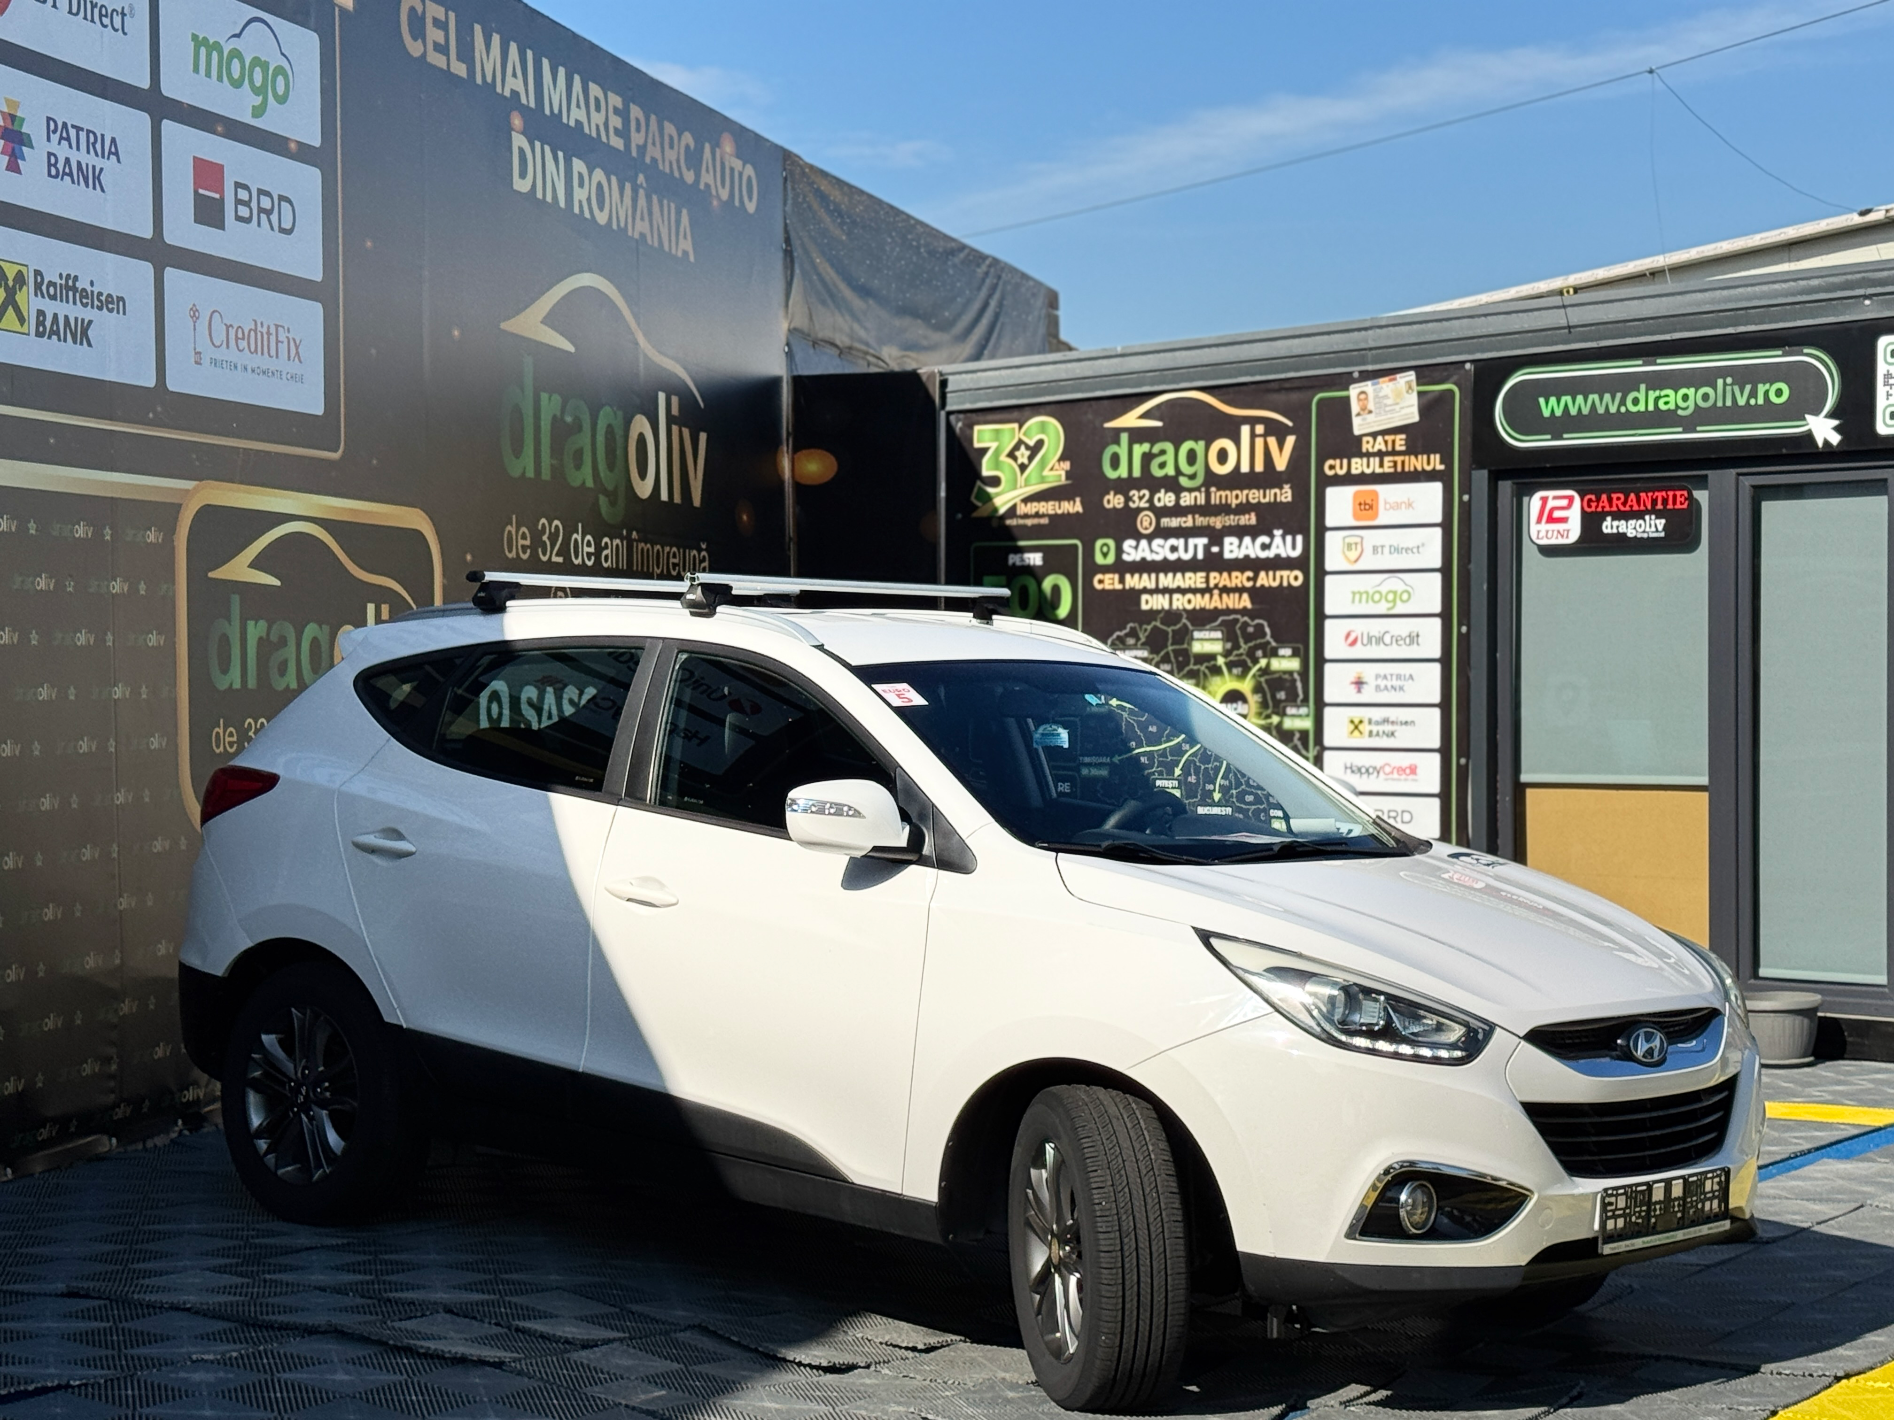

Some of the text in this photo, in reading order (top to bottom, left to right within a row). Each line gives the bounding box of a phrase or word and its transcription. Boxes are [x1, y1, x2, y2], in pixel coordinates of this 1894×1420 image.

[191, 32, 290, 119] mogo
[401, 0, 758, 214] CEL MAI MARE PARC AUTO
[46, 115, 121, 164] PATRIA
[46, 151, 106, 194] BANK
[511, 130, 695, 262] DIN ROMÂNIA
[234, 181, 296, 236] BRD
[33, 269, 127, 316] Raiffeisen
[34, 308, 93, 348] BANK
[207, 309, 303, 364] CreditFix
[1538, 378, 1790, 417] www.dragoliv.ro
[501, 353, 707, 524] dragoliv
[1362, 434, 1407, 453] RATE
[971, 415, 1065, 506] 32
[1102, 424, 1296, 488] dragoliv
[1324, 453, 1445, 475] CU BULETINUL
[1103, 484, 1292, 508] de 32 de ani împreună
[1357, 498, 1415, 512] tbi bank
[1583, 489, 1689, 512] GARANTIE
[1160, 514, 1193, 528] marcă
[1194, 512, 1257, 529] înregistrată
[1535, 495, 1575, 525] 12
[1536, 529, 1570, 540] LUNI
[1602, 514, 1666, 538] dragoliv
[503, 515, 709, 579] de 32 de ani împreună
[1122, 538, 1208, 561] SASCUT
[1223, 529, 1303, 559] BACĂU
[1372, 545, 1386, 556] BT
[1008, 552, 1044, 567] PESTE
[1094, 570, 1304, 589] CEL MAI MARE PARC AUTO
[1140, 589, 1252, 610] DIN ROMÂNIA
[1351, 589, 1412, 611] mogo
[207, 594, 391, 691] drag
[1361, 631, 1420, 647] UniCredit
[1375, 673, 1414, 682] PATRIA
[1375, 684, 1406, 693] BANK
[894, 693, 914, 703] 5
[1368, 718, 1416, 727] Raiffeisen
[1368, 729, 1397, 739] BANK
[212, 717, 267, 753] de 3
[1344, 762, 1419, 779] HappyCredit
